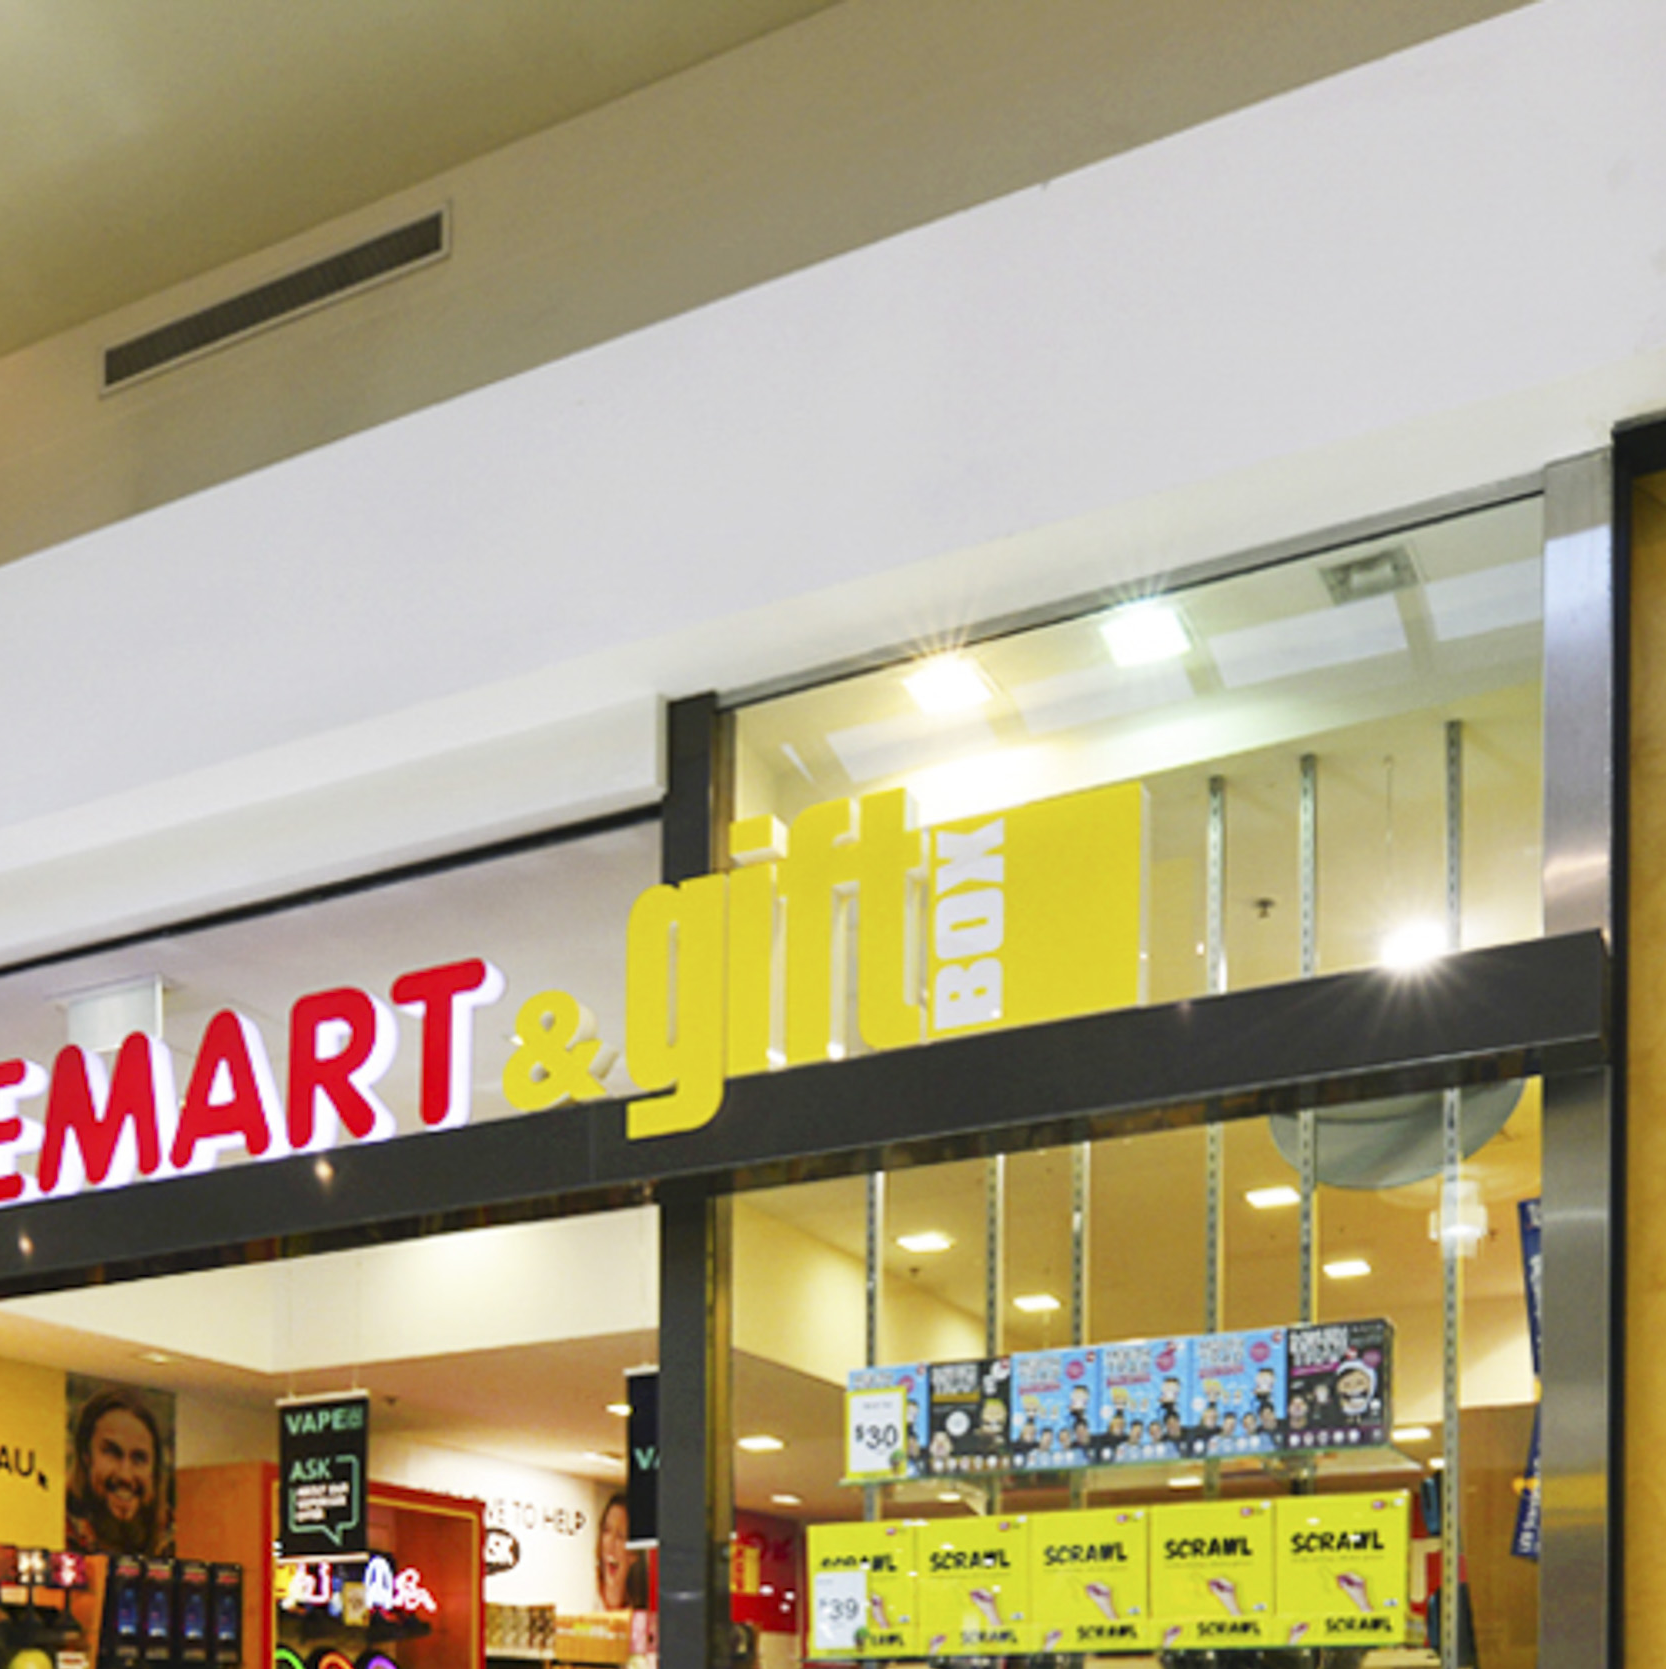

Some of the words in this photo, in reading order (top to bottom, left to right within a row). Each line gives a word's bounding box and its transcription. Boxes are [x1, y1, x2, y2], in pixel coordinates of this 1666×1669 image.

[933, 817, 1005, 1032] BOX
[502, 989, 611, 1111] &
[625, 786, 929, 1140] gift
[854, 1423, 900, 1450] $30
[289, 1457, 332, 1482] ASK
[1043, 1541, 1127, 1567] SCRAWL
[1164, 1536, 1253, 1561] SCRAWL
[1290, 1529, 1385, 1555] SCRAWL
[929, 1548, 1011, 1572] SCRAWL
